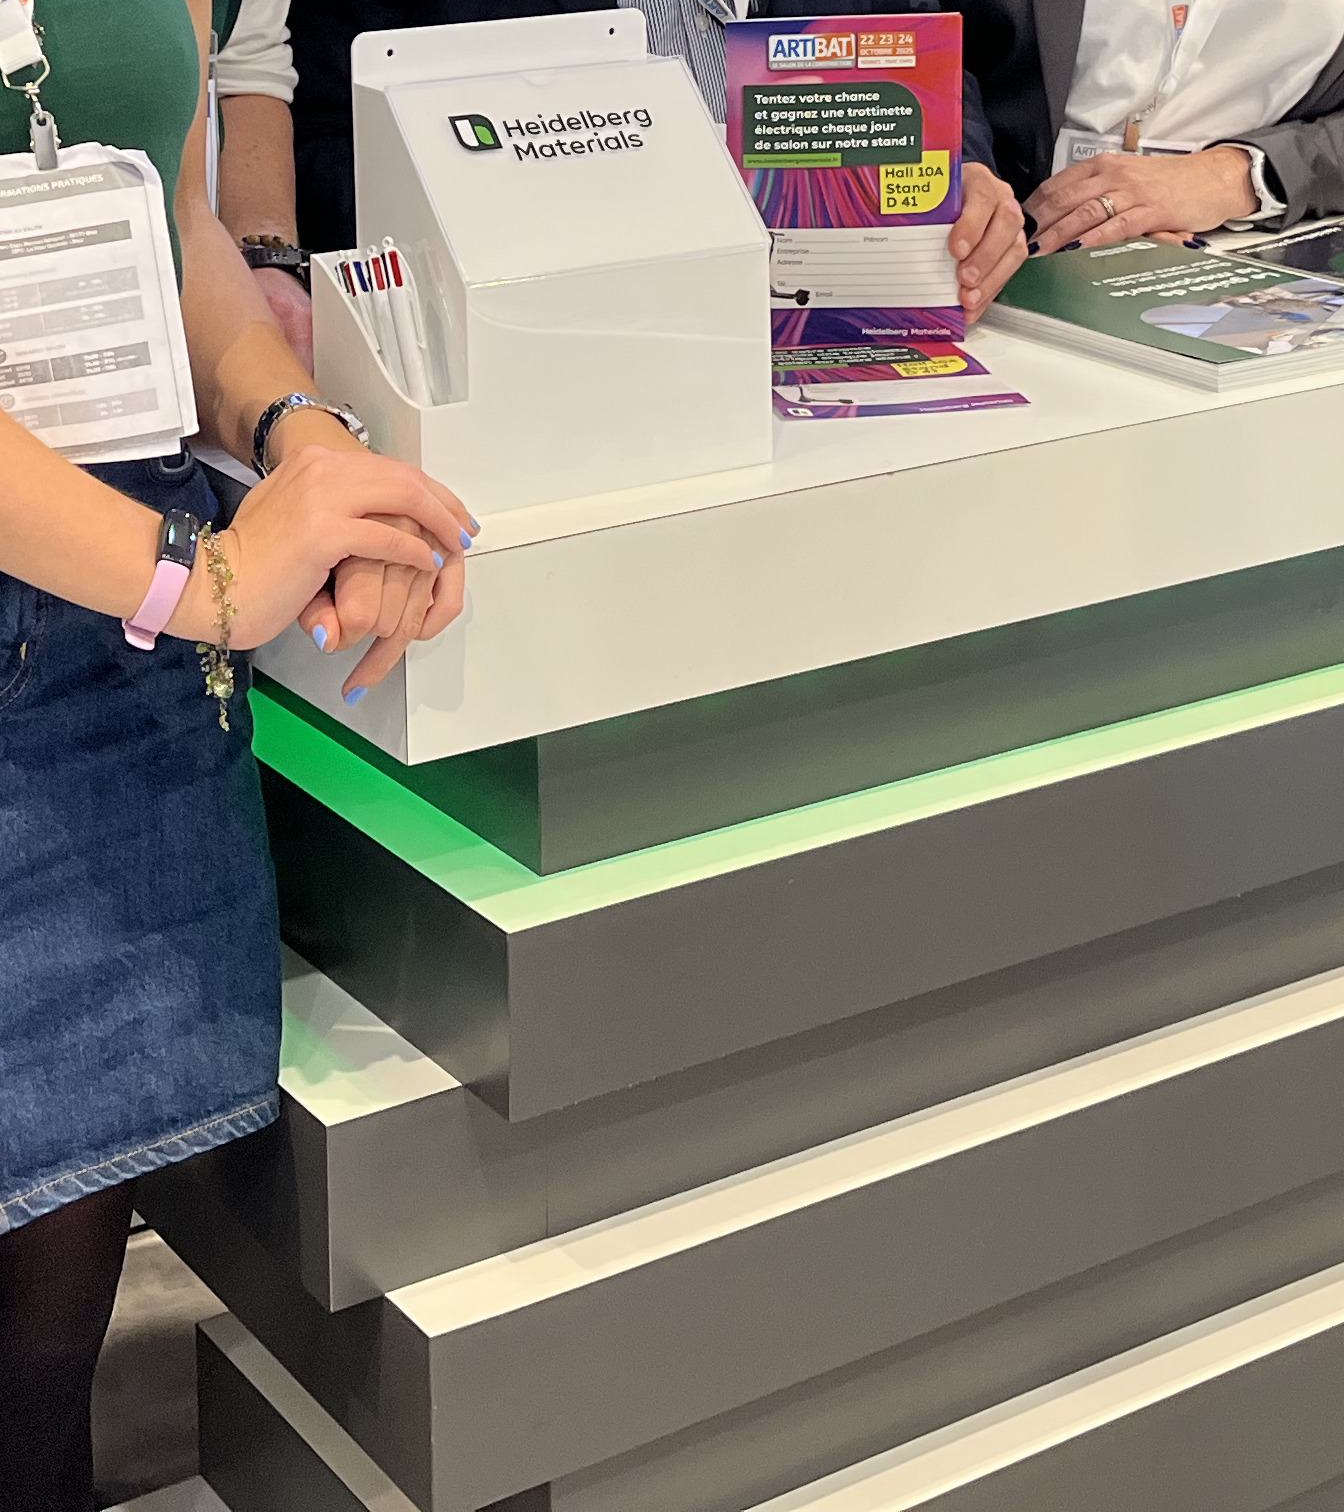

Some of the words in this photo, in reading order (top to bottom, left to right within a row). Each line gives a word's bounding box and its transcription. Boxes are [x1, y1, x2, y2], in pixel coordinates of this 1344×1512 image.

[773, 36, 852, 58] ARTIBAT
[859, 34, 875, 45] 22
[879, 34, 894, 44] 23
[897, 34, 913, 44] 24
[754, 94, 796, 104] Tentez
[799, 94, 832, 103] votre
[835, 92, 881, 102] chance
[754, 110, 768, 120] et
[770, 110, 819, 122] gagnez
[821, 109, 845, 118] une
[847, 105, 914, 117] trottinette
[503, 108, 653, 137] Heidelberg
[754, 123, 819, 136] électrique
[821, 123, 868, 135] chaque
[870, 121, 897, 134] jour
[513, 130, 644, 161] Materials
[754, 140, 772, 150] de
[774, 140, 809, 150] salon
[811, 140, 832, 149] sur
[835, 138, 869, 149] notre
[871, 136, 907, 147] stand
[909, 135, 915, 146] !
[885, 166, 914, 178] Hall
[918, 166, 944, 177] 10A
[51, 173, 104, 190] PRATIQUES
[886, 182, 931, 194] Stand
[886, 198, 897, 208] D
[901, 196, 919, 207] 41
[861, 327, 909, 336] Heidelberg
[910, 328, 952, 336] Materials
